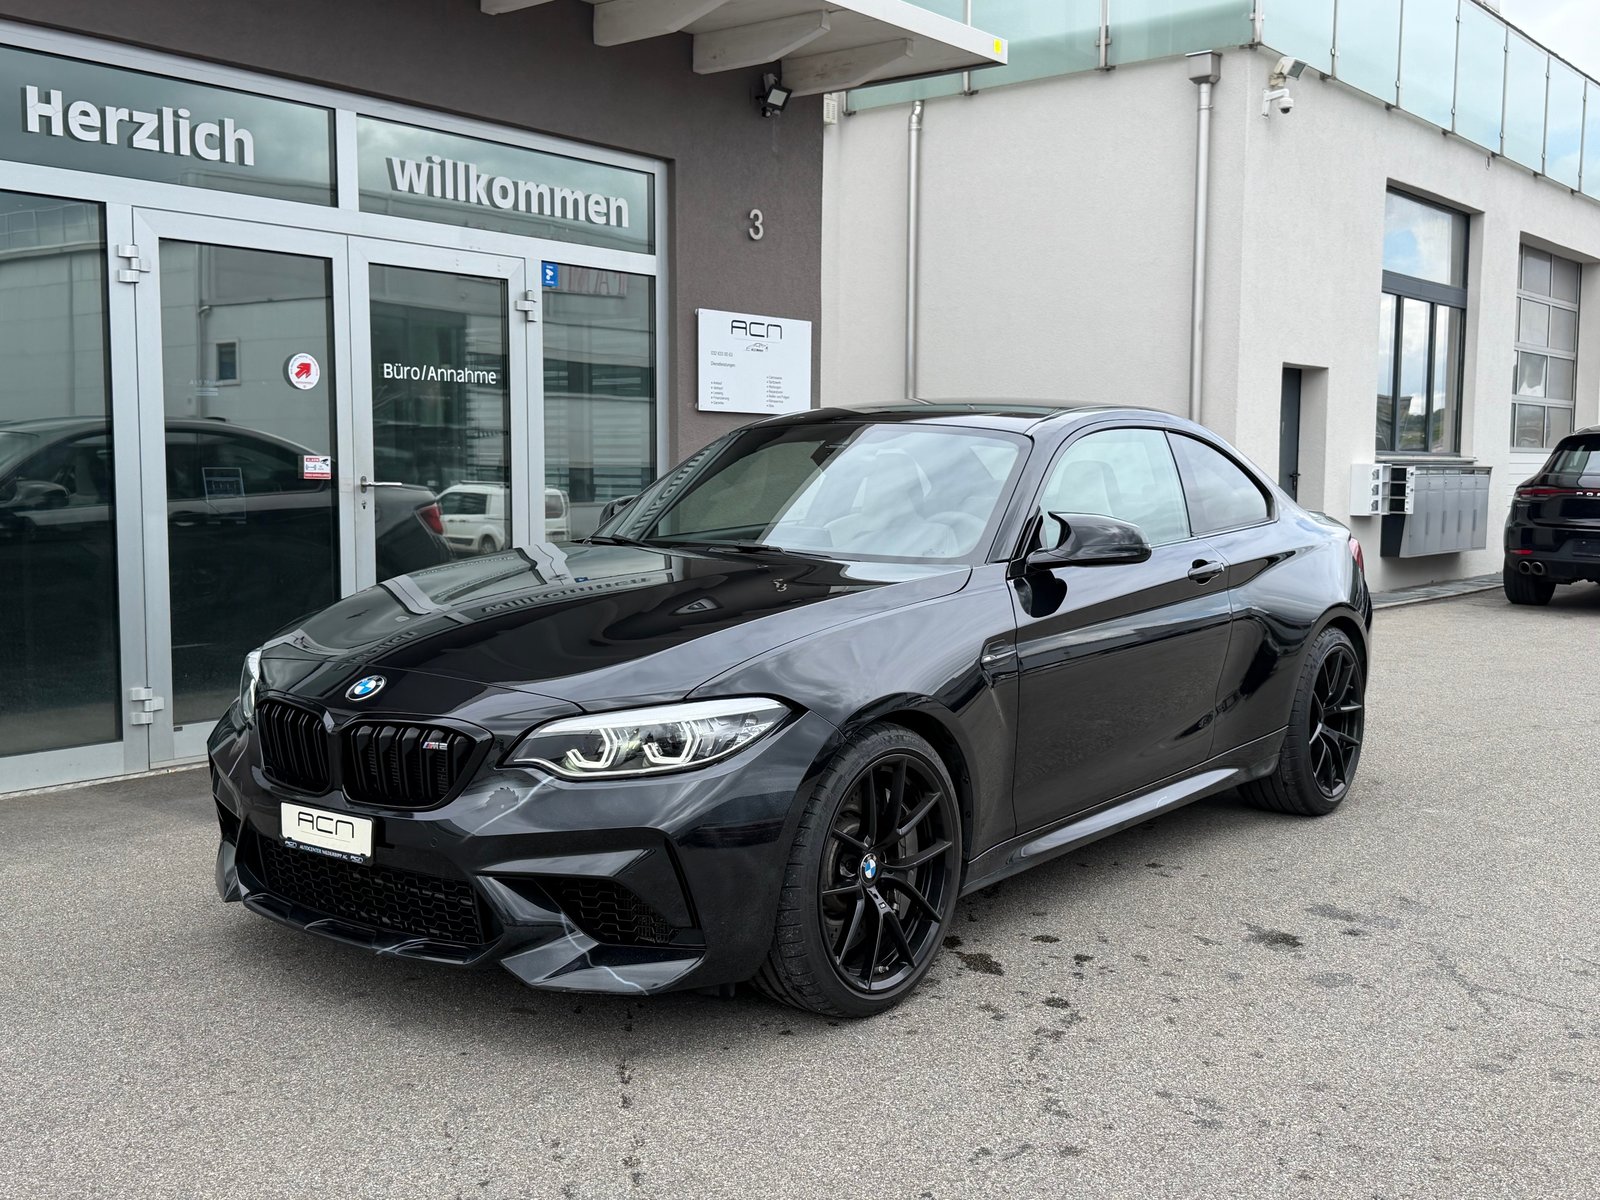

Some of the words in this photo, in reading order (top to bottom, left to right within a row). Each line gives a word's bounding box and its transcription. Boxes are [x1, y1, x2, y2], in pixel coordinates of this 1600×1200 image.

[25, 84, 255, 167] Herzlich
[388, 154, 630, 229] willkommen
[749, 208, 764, 240] 3
[731, 320, 783, 340] ACN
[383, 363, 497, 384] Büro/Annahme
[298, 812, 355, 838] ACN
